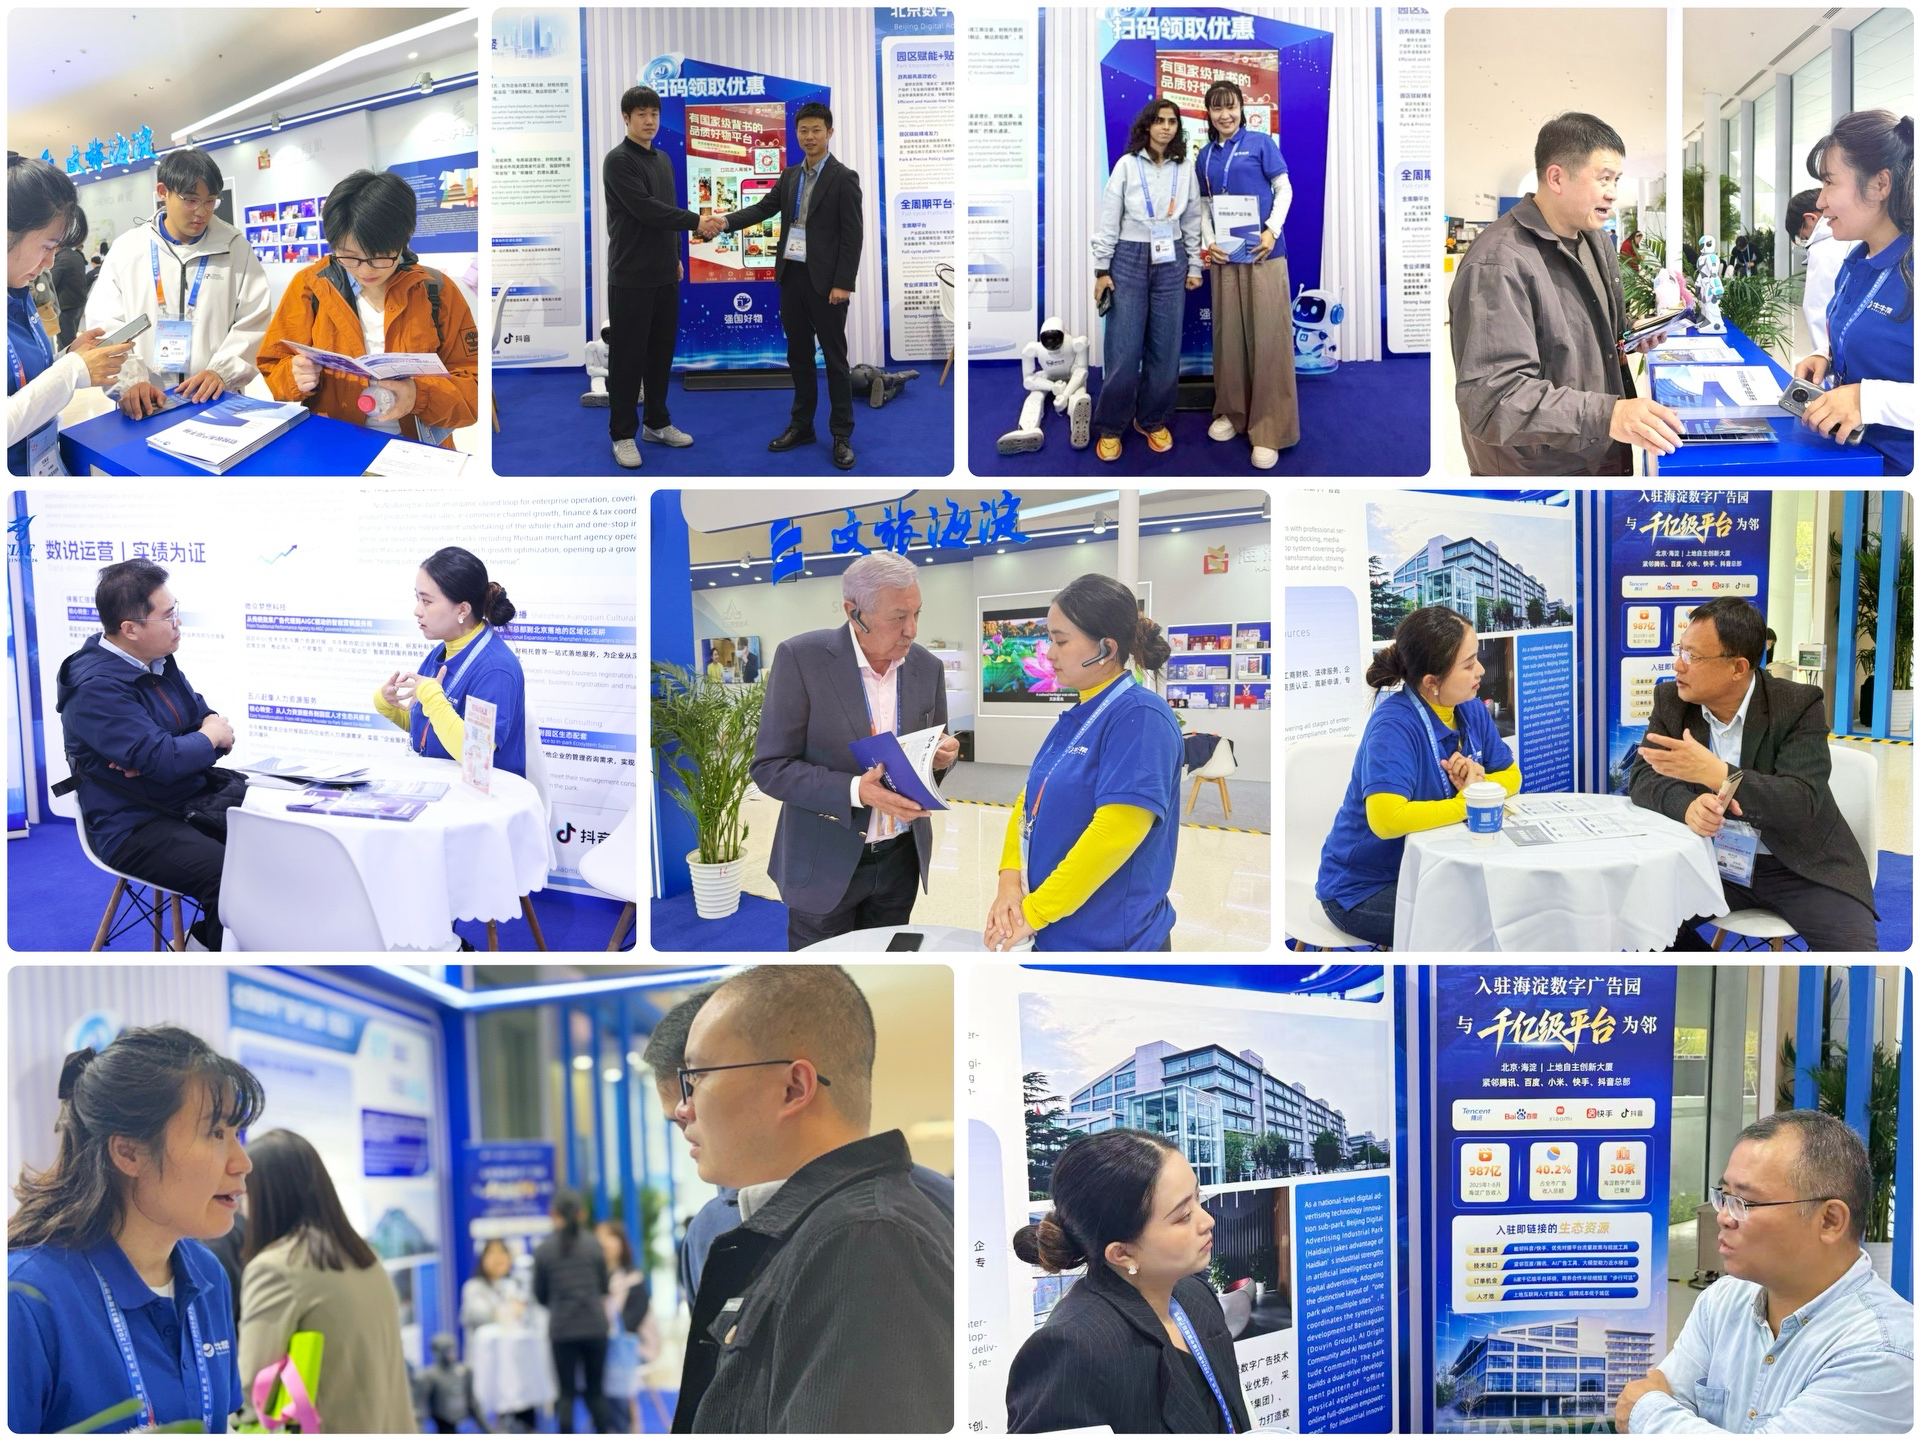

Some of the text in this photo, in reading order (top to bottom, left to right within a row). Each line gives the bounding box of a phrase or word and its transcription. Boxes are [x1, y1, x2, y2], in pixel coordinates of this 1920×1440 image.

[894, 23, 918, 31] Beijing
[1112, 16, 1255, 40] 扫码领取优惠
[655, 67, 665, 75] AI
[1161, 60, 1251, 87] 有国家级背书的
[651, 76, 765, 98] 扫码领取优惠
[689, 113, 763, 133] 有国家级背书的
[689, 126, 752, 144] 品质好物平台
[724, 314, 763, 324] 强国好物
[532, 497, 569, 506] enterprise
[571, 496, 609, 504] operation,
[1639, 490, 1749, 504] 入驻海淀数字广告园
[533, 510, 560, 518] growth,
[614, 507, 636, 515] coord
[1625, 511, 1759, 546] 与 千亿级平台 为邻
[1633, 622, 1655, 630] 987亿
[576, 681, 609, 689] registration
[564, 718, 602, 728] Consulting
[580, 776, 619, 785] management
[1475, 976, 1641, 995] 入驻海淀数字广告园
[1456, 1006, 1657, 1057] 与 千亿级平台 为邻
[1482, 1078, 1631, 1087] 紧邻腾讯、百度、小米、快手、抖音总部
[1597, 1109, 1613, 1118] 快手
[1469, 1165, 1502, 1176] 987亿
[1536, 1165, 1571, 1175] 40.2%
[1610, 1164, 1635, 1174] 30家
[1318, 1193, 1373, 1206] national-level digital
[1305, 1207, 1362, 1220] vertising technology
[1347, 1218, 1365, 1226] Beijing
[1366, 1215, 1383, 1223] Digital
[1496, 1222, 1610, 1235] 入驻即链接的生态资源
[1306, 1234, 1340, 1244] Advertising
[1342, 1229, 1370, 1238] Industrial
[974, 1240, 985, 1252] 企
[1306, 1246, 1332, 1258] (Haidian)
[1349, 1239, 1377, 1249] advantage
[975, 1257, 986, 1268] 专
[1336, 1249, 1383, 1264] industrial strengths
[1314, 1269, 1338, 1279] artificial
[1339, 1263, 1372, 1274] intelligence
[1306, 1272, 1384, 1294] digital Adopting
[1317, 1288, 1362, 1302] distinctive layout
[1307, 1309, 1320, 1319] park
[1335, 1300, 1358, 1310] multiple
[1307, 1305, 1384, 1329] coordinates synergistic
[1307, 1317, 1384, 1341] development Beixiaguan
[1307, 1328, 1384, 1354] (Douyin Origin
[1308, 1341, 1372, 1365] Community and North
[1372, 1349, 1384, 1359] park
[1308, 1369, 1360, 1389] builds dual-drive
[1308, 1383, 1350, 1401] ment pattern
[1308, 1384, 1380, 1415] physical agglomeration
[1258, 1408, 1289, 1426] 力打造数
[1308, 1403, 1358, 1426] online full-domain
[1339, 1411, 1365, 1426] industrial
